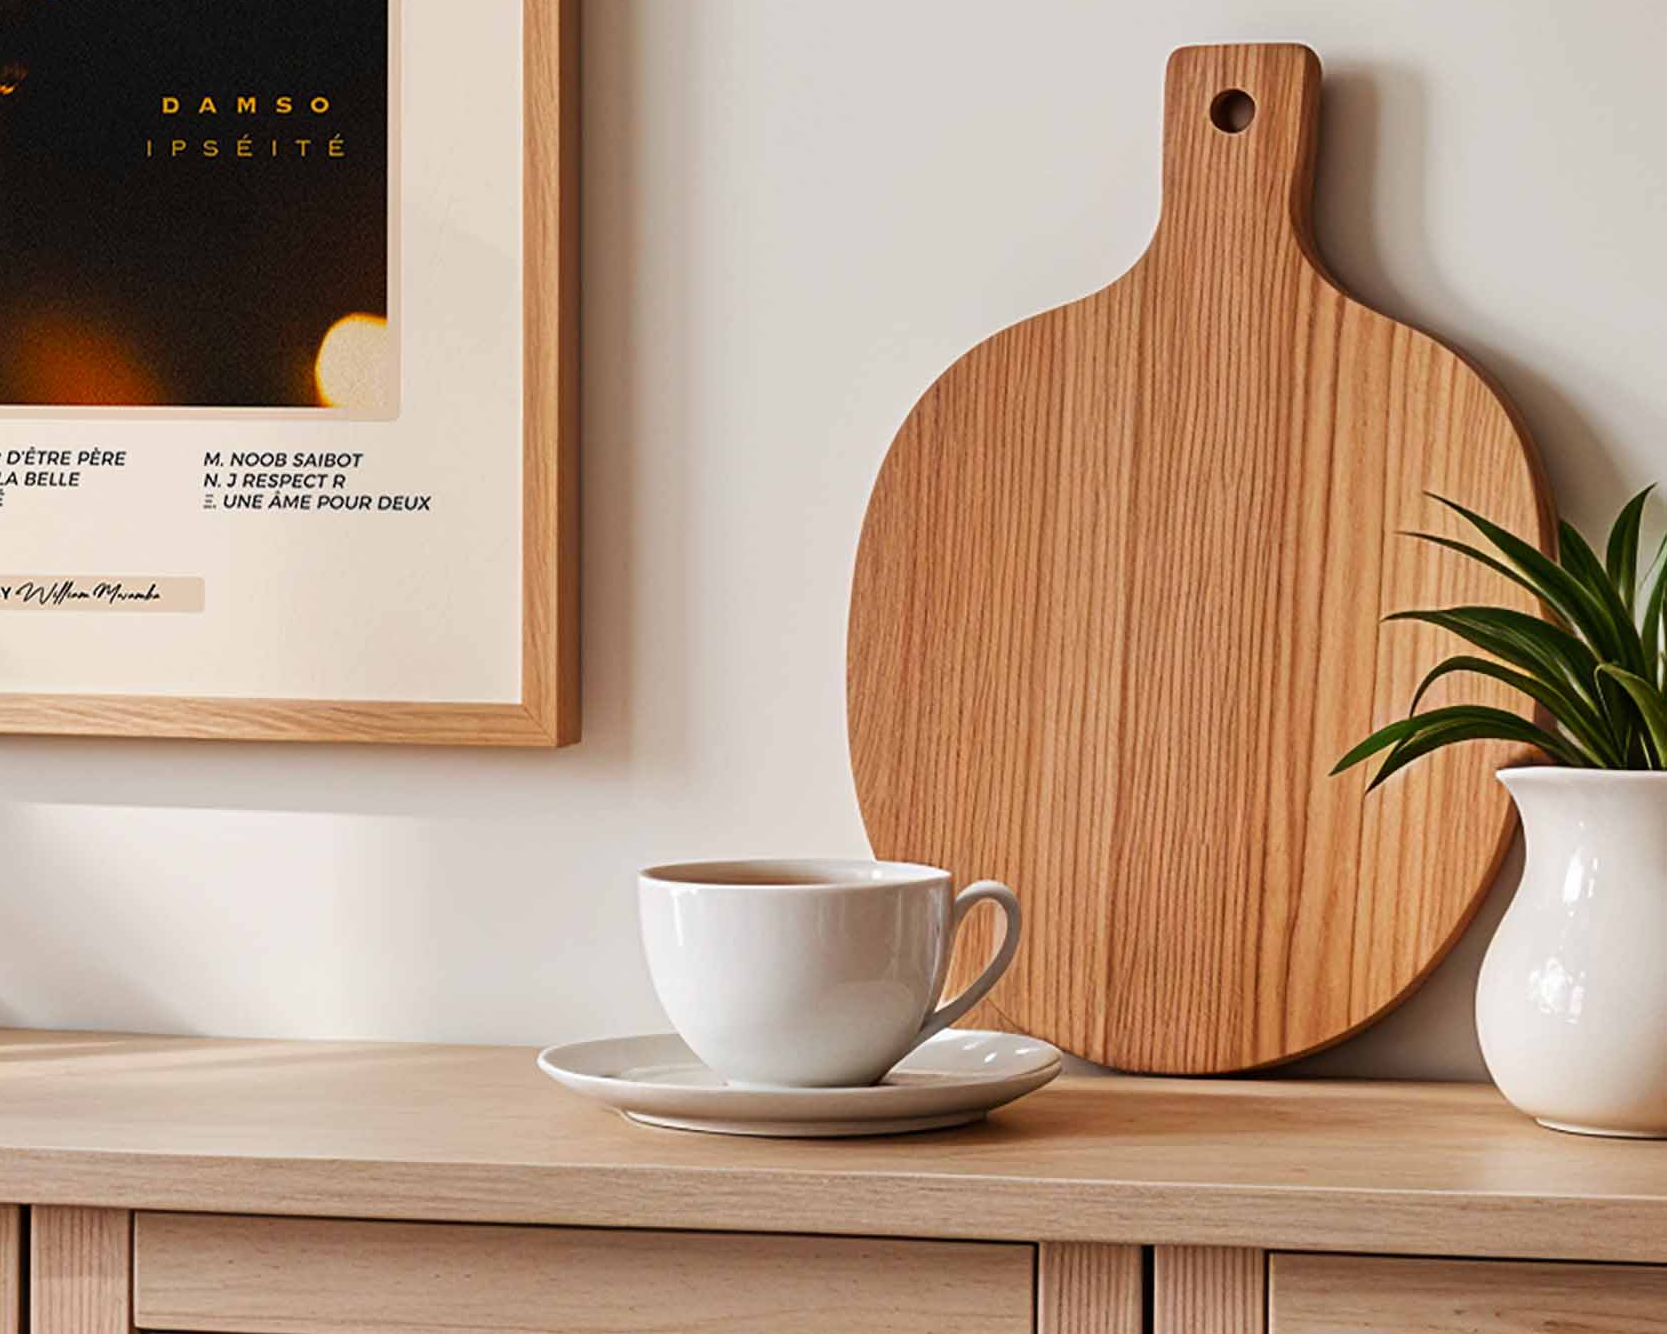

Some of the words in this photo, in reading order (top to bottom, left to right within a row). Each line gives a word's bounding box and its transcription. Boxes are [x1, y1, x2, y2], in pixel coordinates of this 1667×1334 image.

[162, 97, 330, 114] DAMSO
[145, 134, 346, 157] IPSÉITÉ
[77, 447, 126, 466] PÈRE
[204, 452, 223, 467] M.
[230, 452, 287, 467] NOOB
[293, 453, 363, 468] SAIBOT
[24, 471, 80, 487] BELLE
[204, 473, 221, 488] N.
[227, 473, 237, 488] J
[242, 473, 328, 489] RESPECT
[333, 474, 346, 489] R
[224, 494, 263, 509] UNE
[268, 491, 312, 510] ÂME
[317, 495, 372, 510] POUR
[378, 495, 431, 511] DEUX
